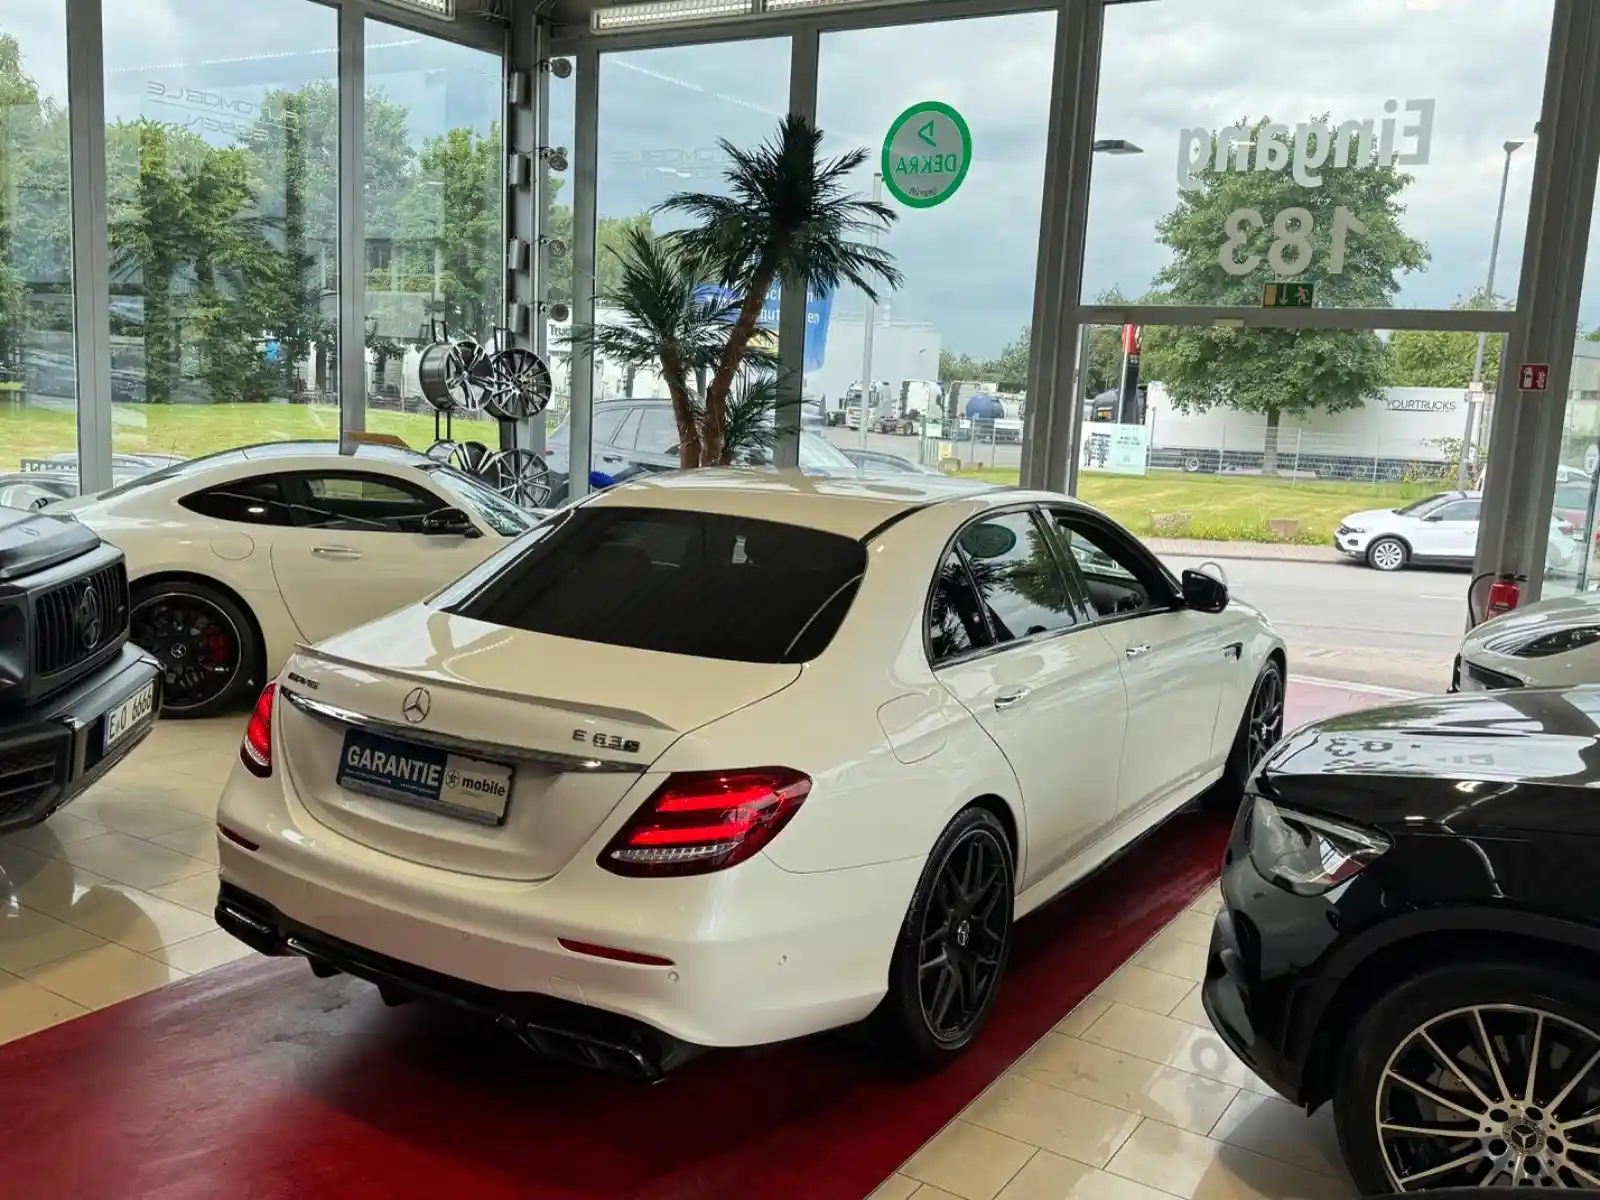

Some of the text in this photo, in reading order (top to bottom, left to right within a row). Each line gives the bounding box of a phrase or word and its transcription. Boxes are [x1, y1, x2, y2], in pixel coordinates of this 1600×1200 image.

[1386, 399, 1457, 411] YOURTRUCKS
[572, 729, 587, 741] E
[346, 745, 442, 787] GARANTIE
[462, 775, 505, 797] mobile
